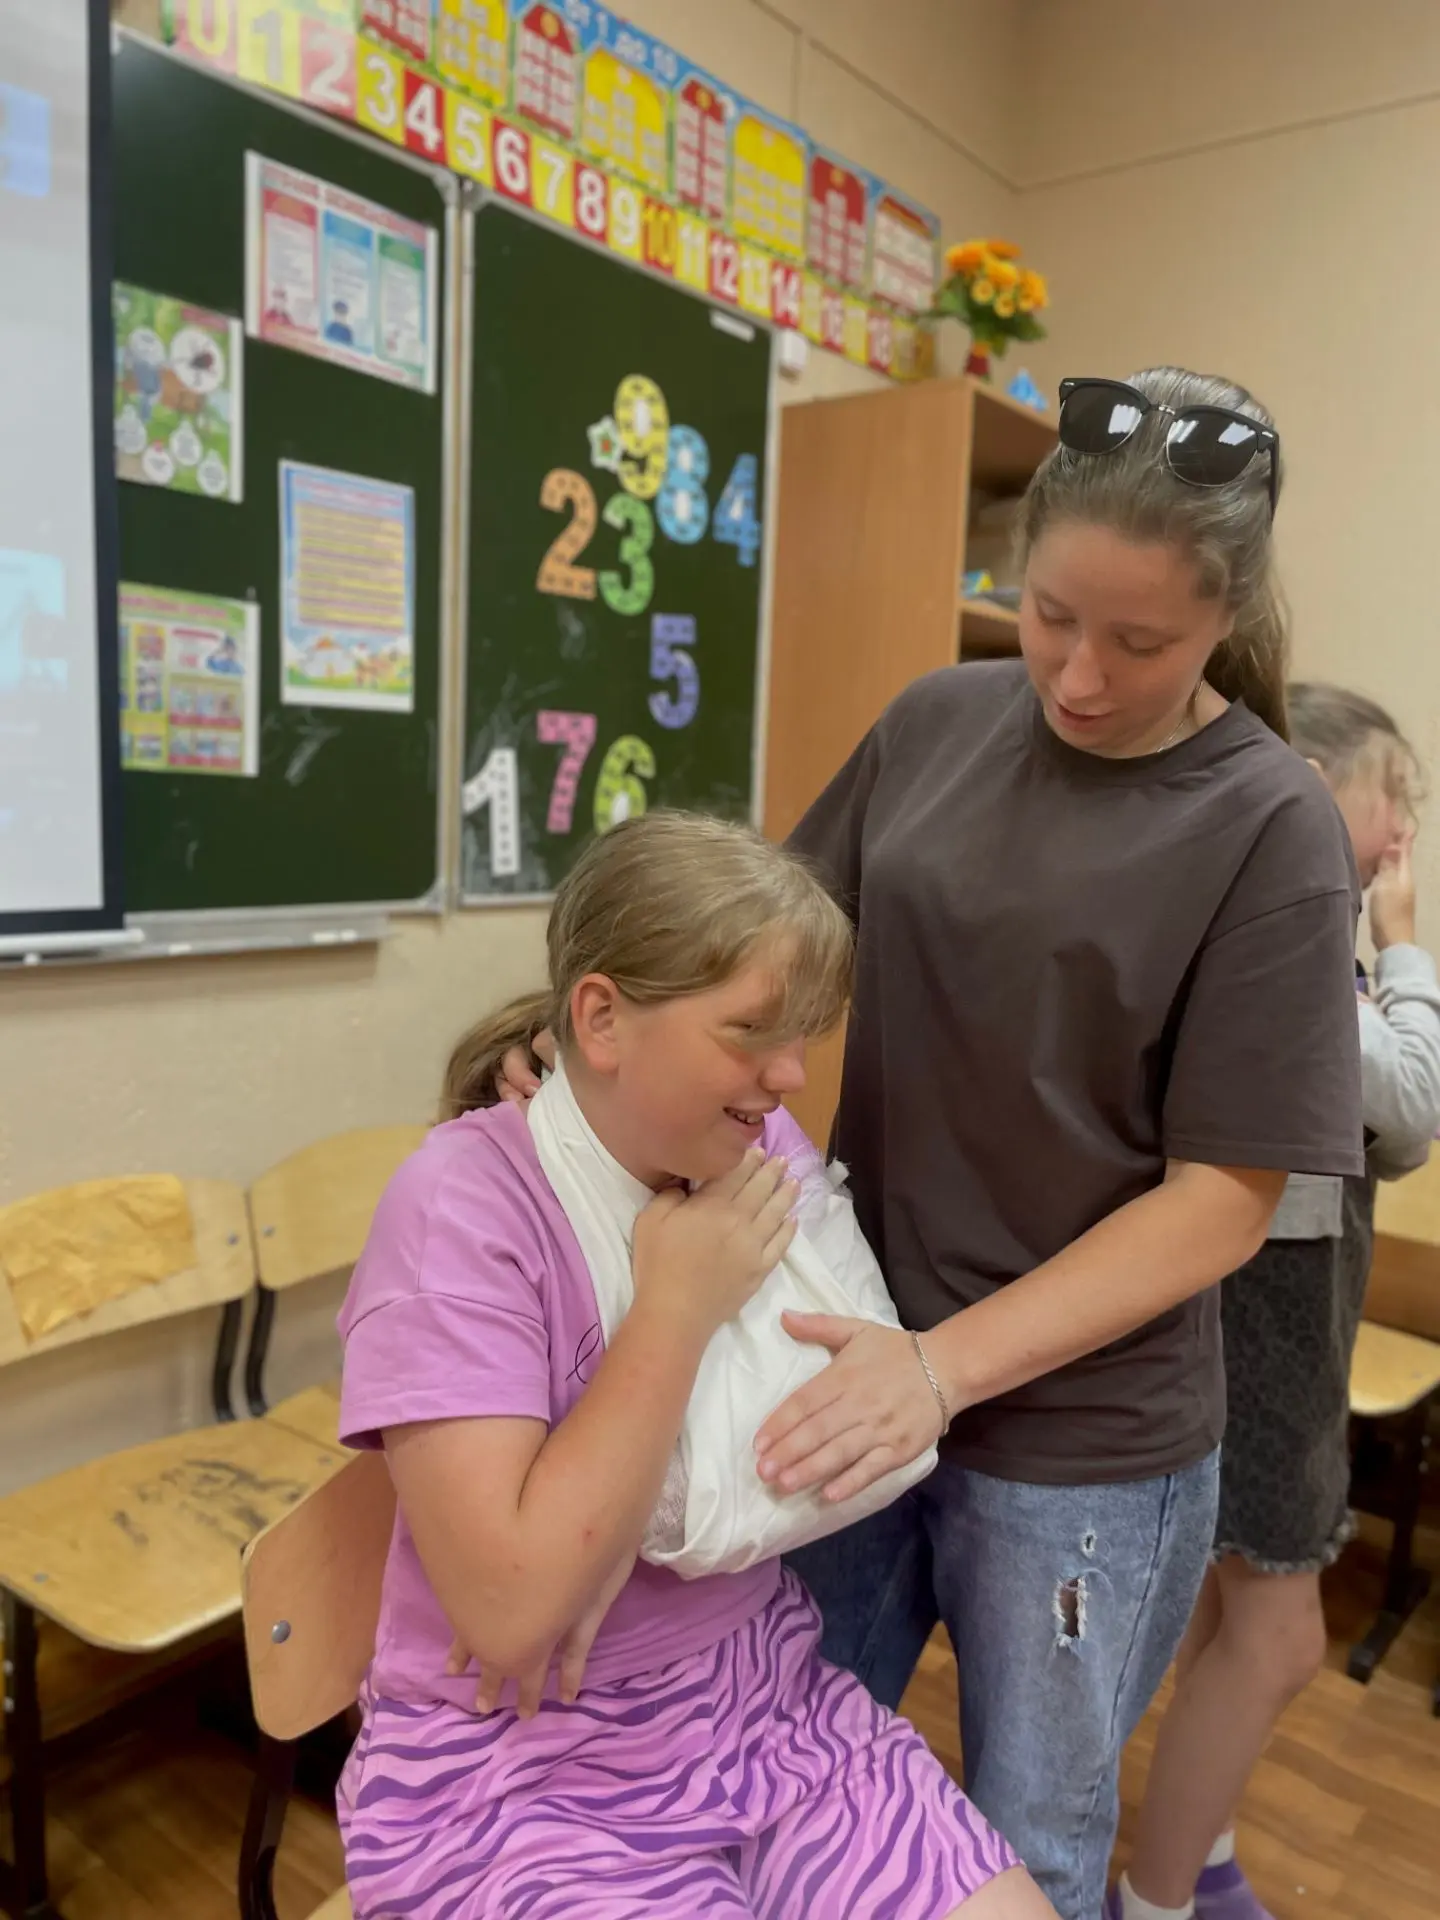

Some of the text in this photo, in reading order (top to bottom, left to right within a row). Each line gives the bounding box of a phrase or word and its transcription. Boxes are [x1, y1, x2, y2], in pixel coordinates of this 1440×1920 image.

[188, 0, 229, 56] 0
[252, 10, 283, 82] 1
[308, 29, 351, 108] 2
[365, 54, 398, 128] 3
[405, 83, 442, 152] 4
[454, 102, 486, 172] 5
[493, 128, 528, 193] 6
[538, 149, 566, 210] 7
[577, 168, 607, 233] 8
[610, 187, 640, 248] 9
[643, 205, 676, 265] 10
[678, 222, 706, 279] 11
[711, 237, 740, 298] 12
[772, 266, 800, 325] 14
[614, 373, 669, 499] 9
[655, 424, 710, 544] 8
[536, 468, 598, 600] 2
[600, 492, 655, 616] 3
[713, 453, 760, 567] 4
[648, 612, 700, 730] 5
[462, 747, 521, 877] 1
[537, 709, 597, 834] 7
[593, 734, 656, 834] 6
